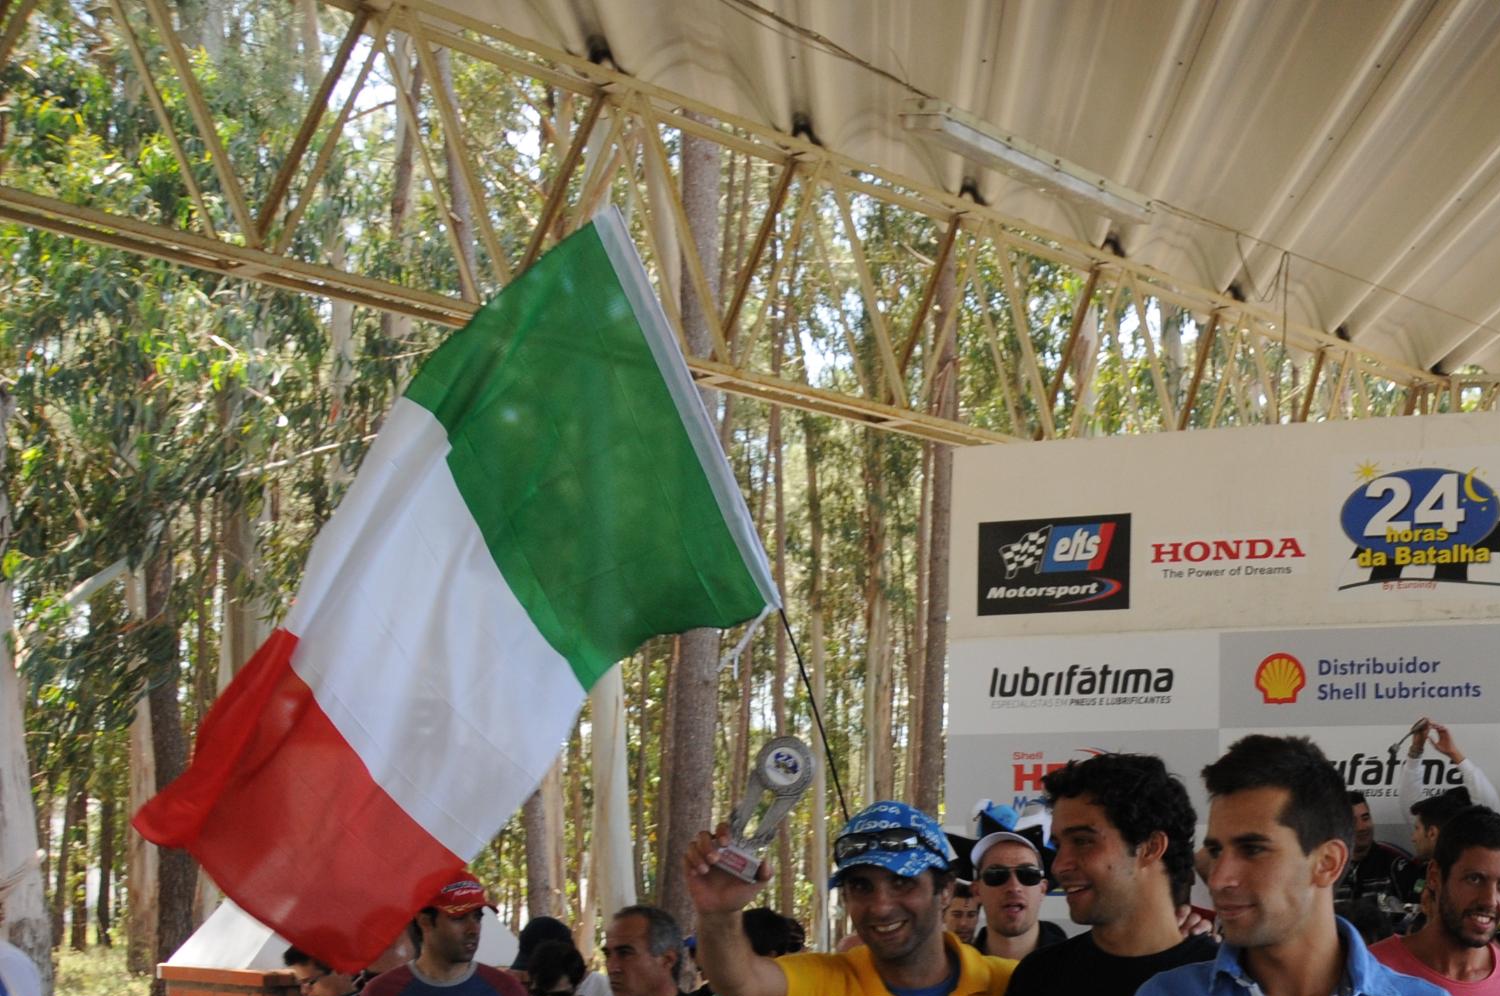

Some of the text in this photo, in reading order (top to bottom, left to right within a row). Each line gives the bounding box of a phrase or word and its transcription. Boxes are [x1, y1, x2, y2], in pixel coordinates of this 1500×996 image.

[1363, 472, 1466, 537] 24
[1385, 526, 1449, 543] horas
[1151, 537, 1306, 563] HONDA
[1357, 544, 1491, 567] da Batalha
[1163, 564, 1292, 579] The Power of Dreams
[986, 580, 1098, 600] Motorsport
[1318, 657, 1440, 676] Distribuidor
[989, 664, 1174, 698] lubrifátima
[1317, 680, 1481, 701] Shell Lubricants
[1069, 697, 1097, 707] PNEUS
[1013, 751, 1043, 760] Shell
